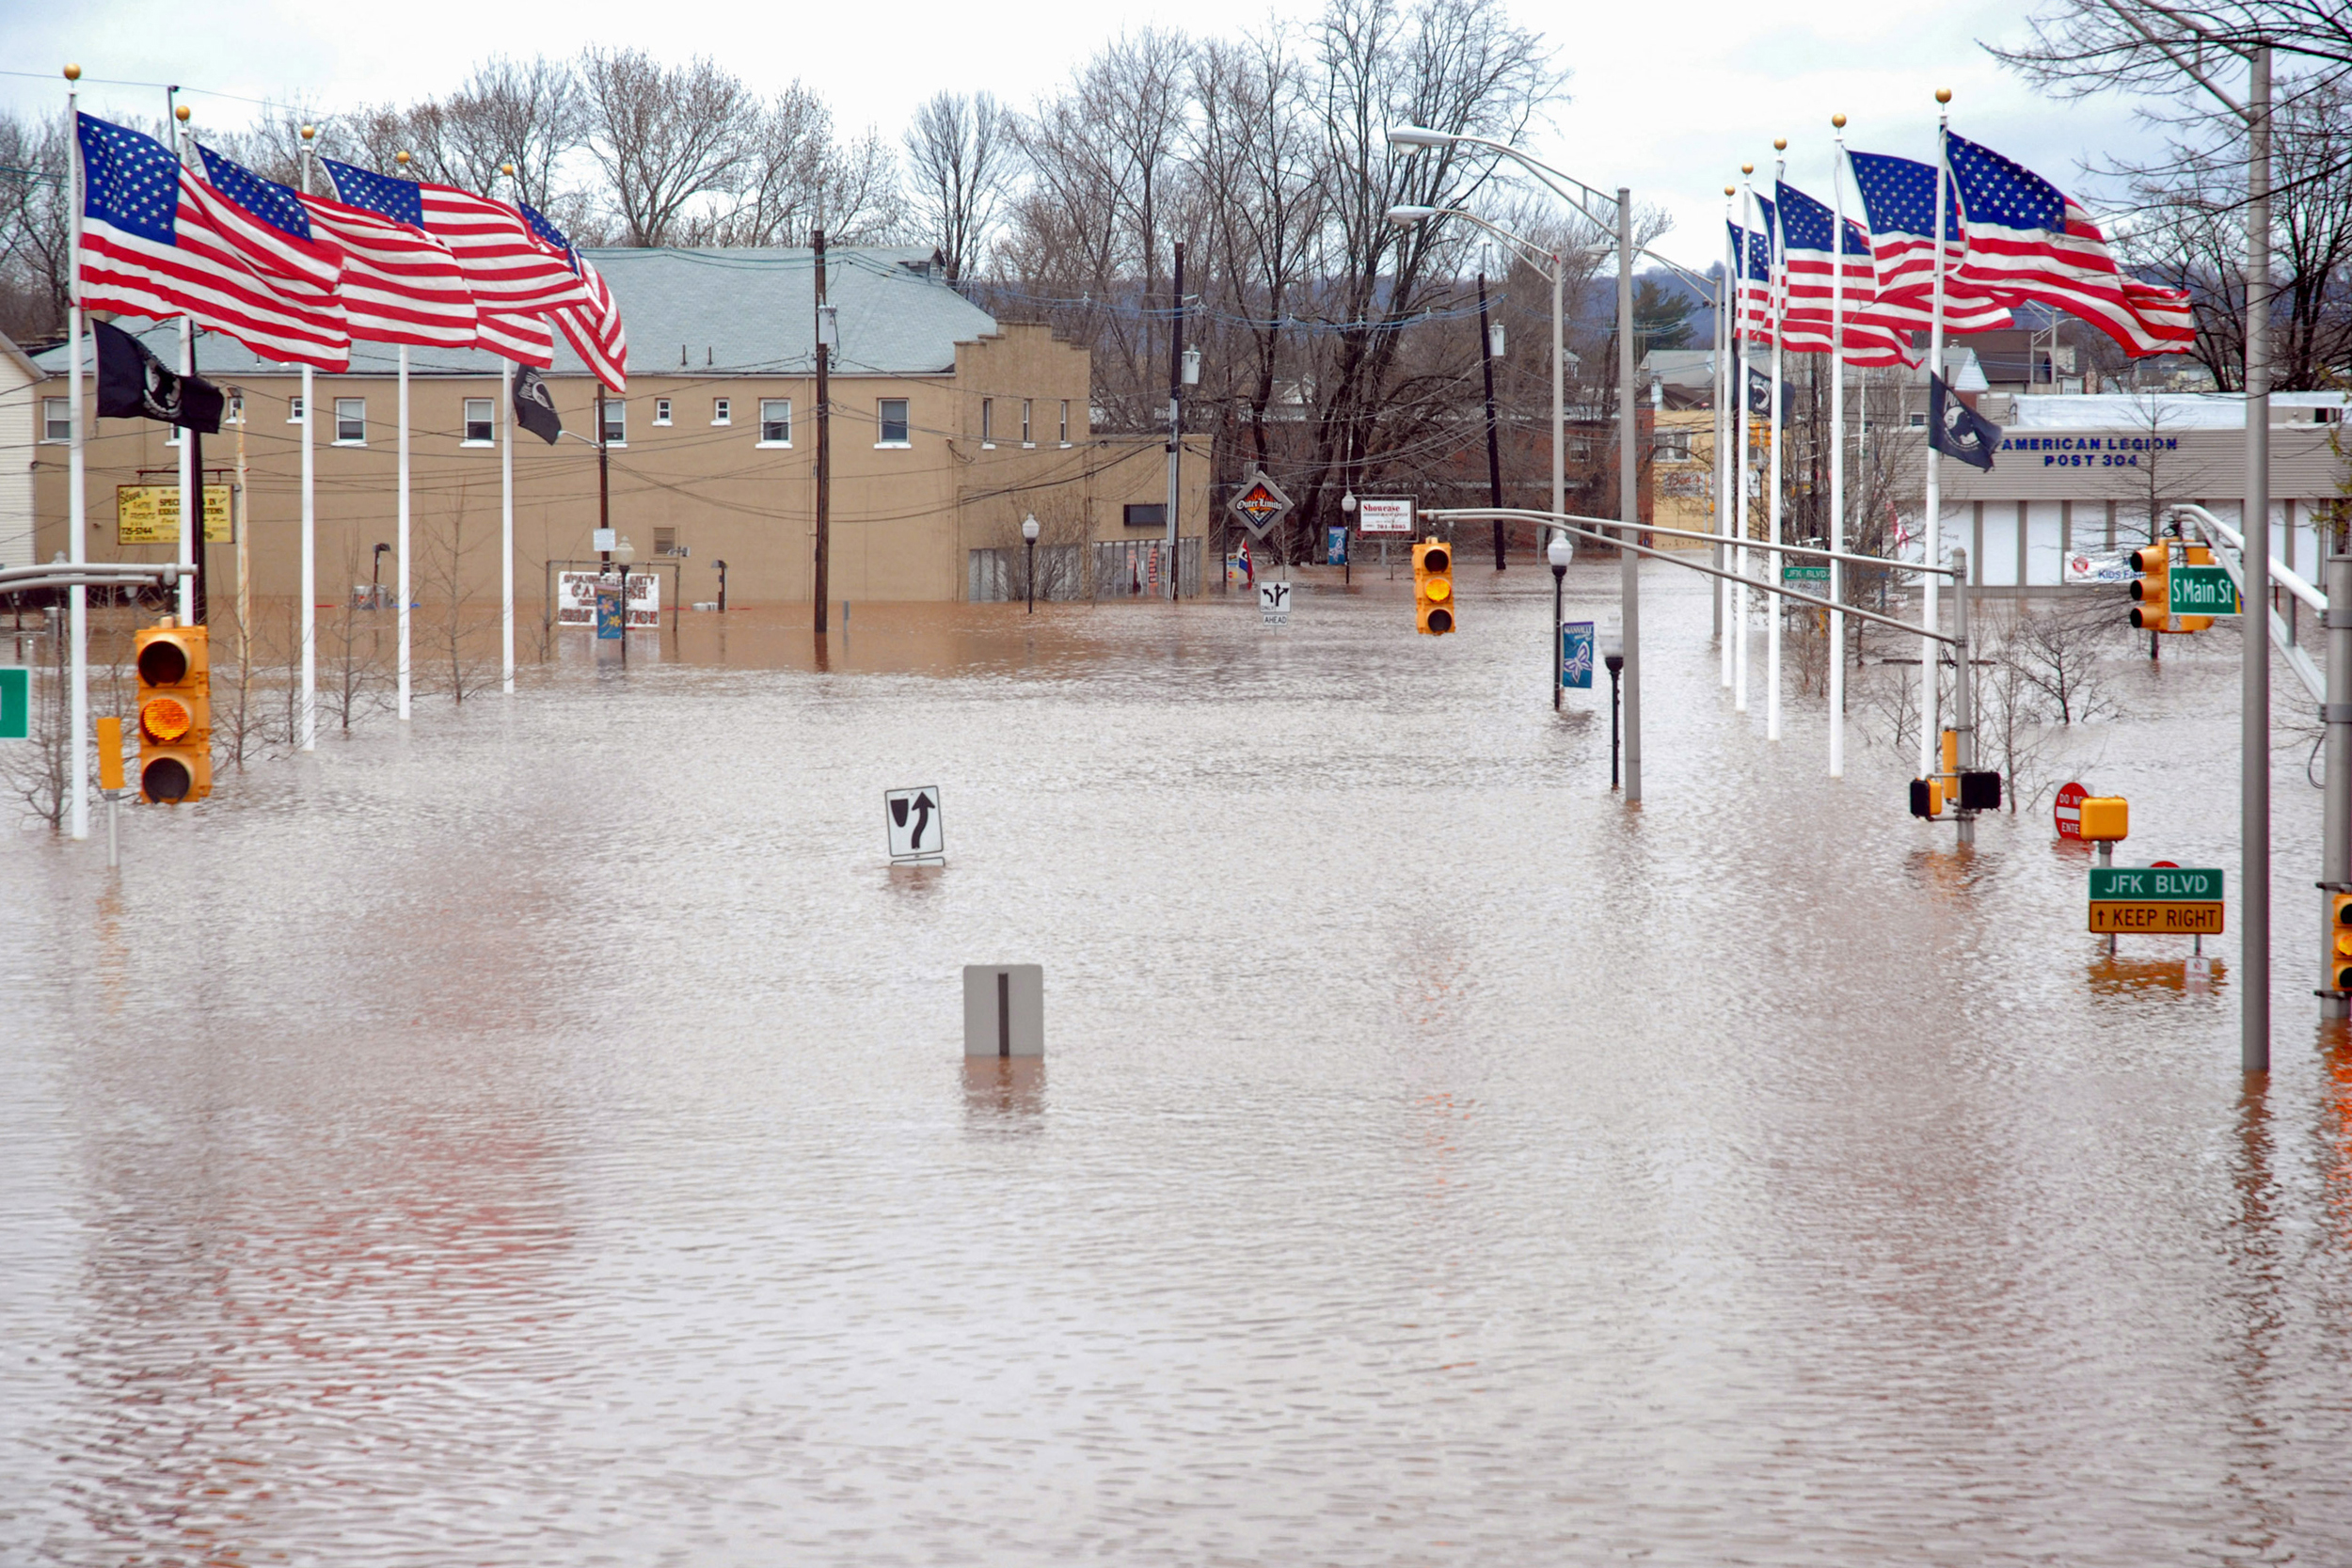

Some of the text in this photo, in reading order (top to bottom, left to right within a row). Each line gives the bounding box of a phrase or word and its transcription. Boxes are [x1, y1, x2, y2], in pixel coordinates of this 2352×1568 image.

[2001, 437, 2178, 451] AMERICAN LEGION
[2044, 454, 2138, 467] POST 304
[1236, 498, 1283, 511] Outer Limits
[1363, 503, 1401, 512] Showcase
[1806, 570, 1826, 578] BLVD
[2098, 569, 2122, 579] KIDS
[2172, 578, 2233, 603] S Main St
[1263, 616, 1287, 625] AHEAD
[2059, 793, 2070, 805] DO
[2061, 821, 2081, 834] ENTE
[2105, 875, 2208, 894] JFK BLVD
[2113, 909, 2217, 927] KEEP RIGHT
